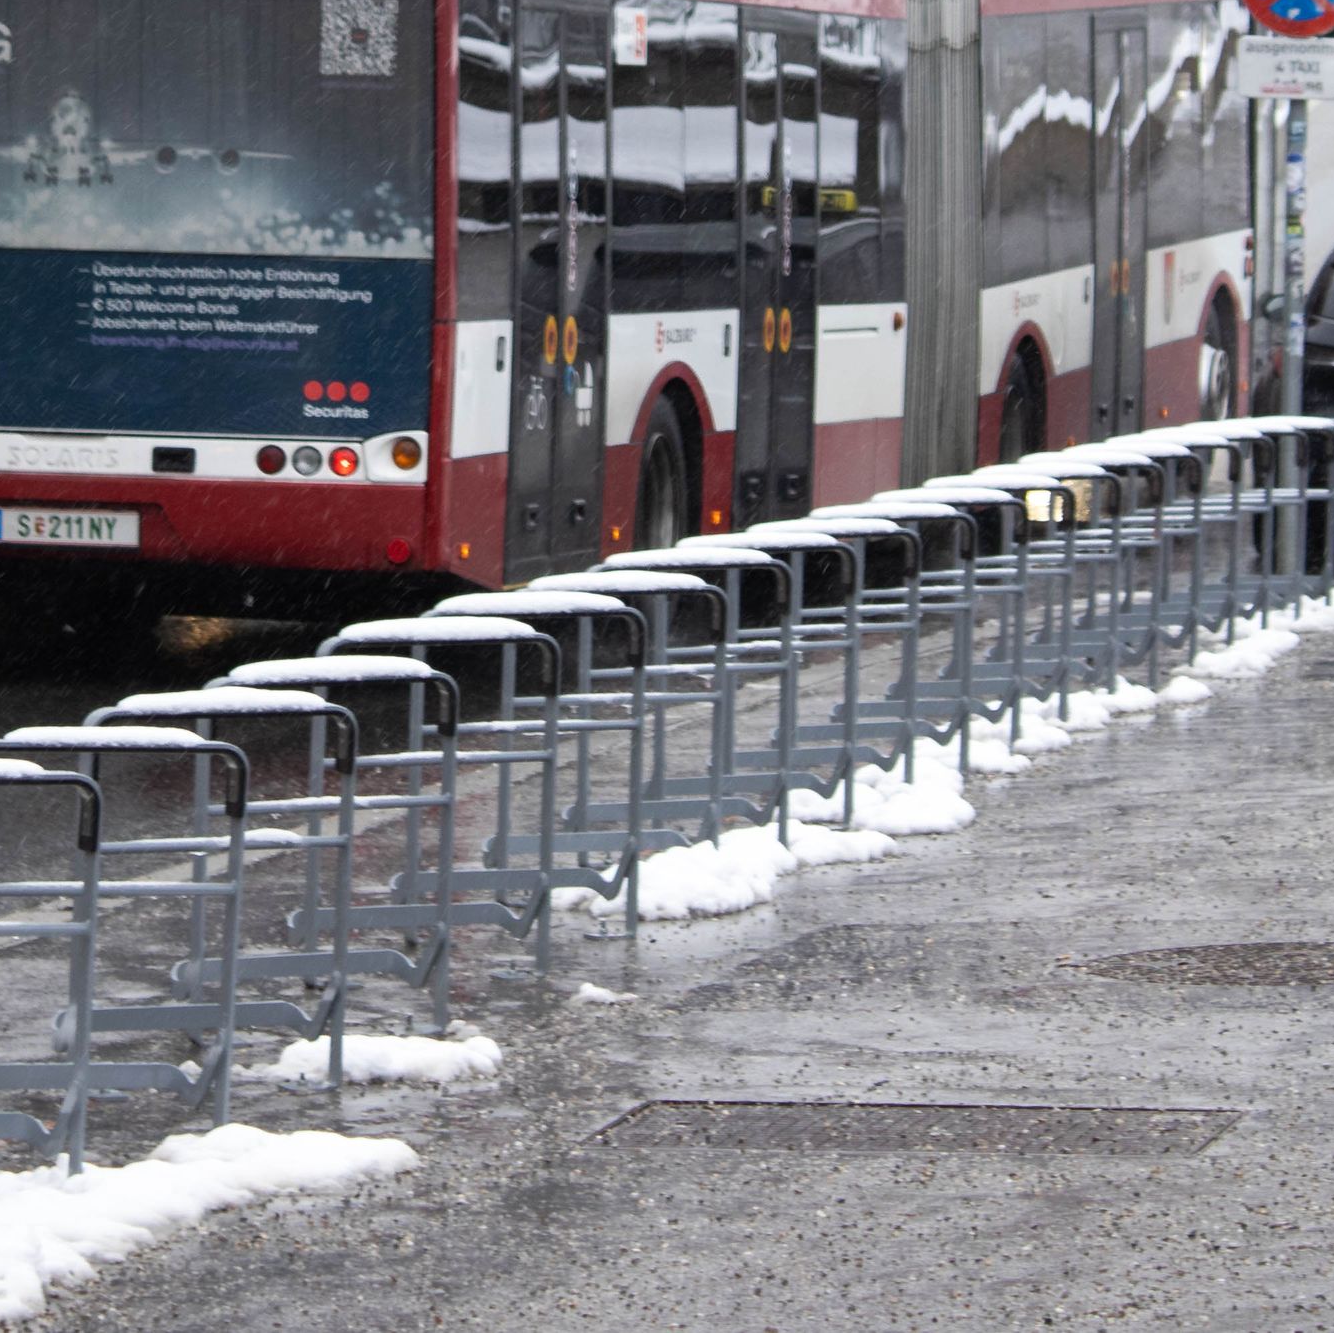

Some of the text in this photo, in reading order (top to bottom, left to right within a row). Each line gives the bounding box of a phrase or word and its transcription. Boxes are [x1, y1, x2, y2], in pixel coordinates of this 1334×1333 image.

[229, 267, 264, 281] hohe
[264, 267, 340, 285] Entlohnung
[158, 284, 186, 296] und
[187, 284, 275, 301] geringfügiger
[275, 285, 373, 304] Beschäftigung
[91, 297, 240, 315] € 500 Welcome Bonus
[91, 316, 320, 334] Jobsicherheit beim Weltmarktführer
[302, 404, 370, 420] Securitas
[8, 446, 117, 468] SOLARIS
[17, 514, 31, 538] S
